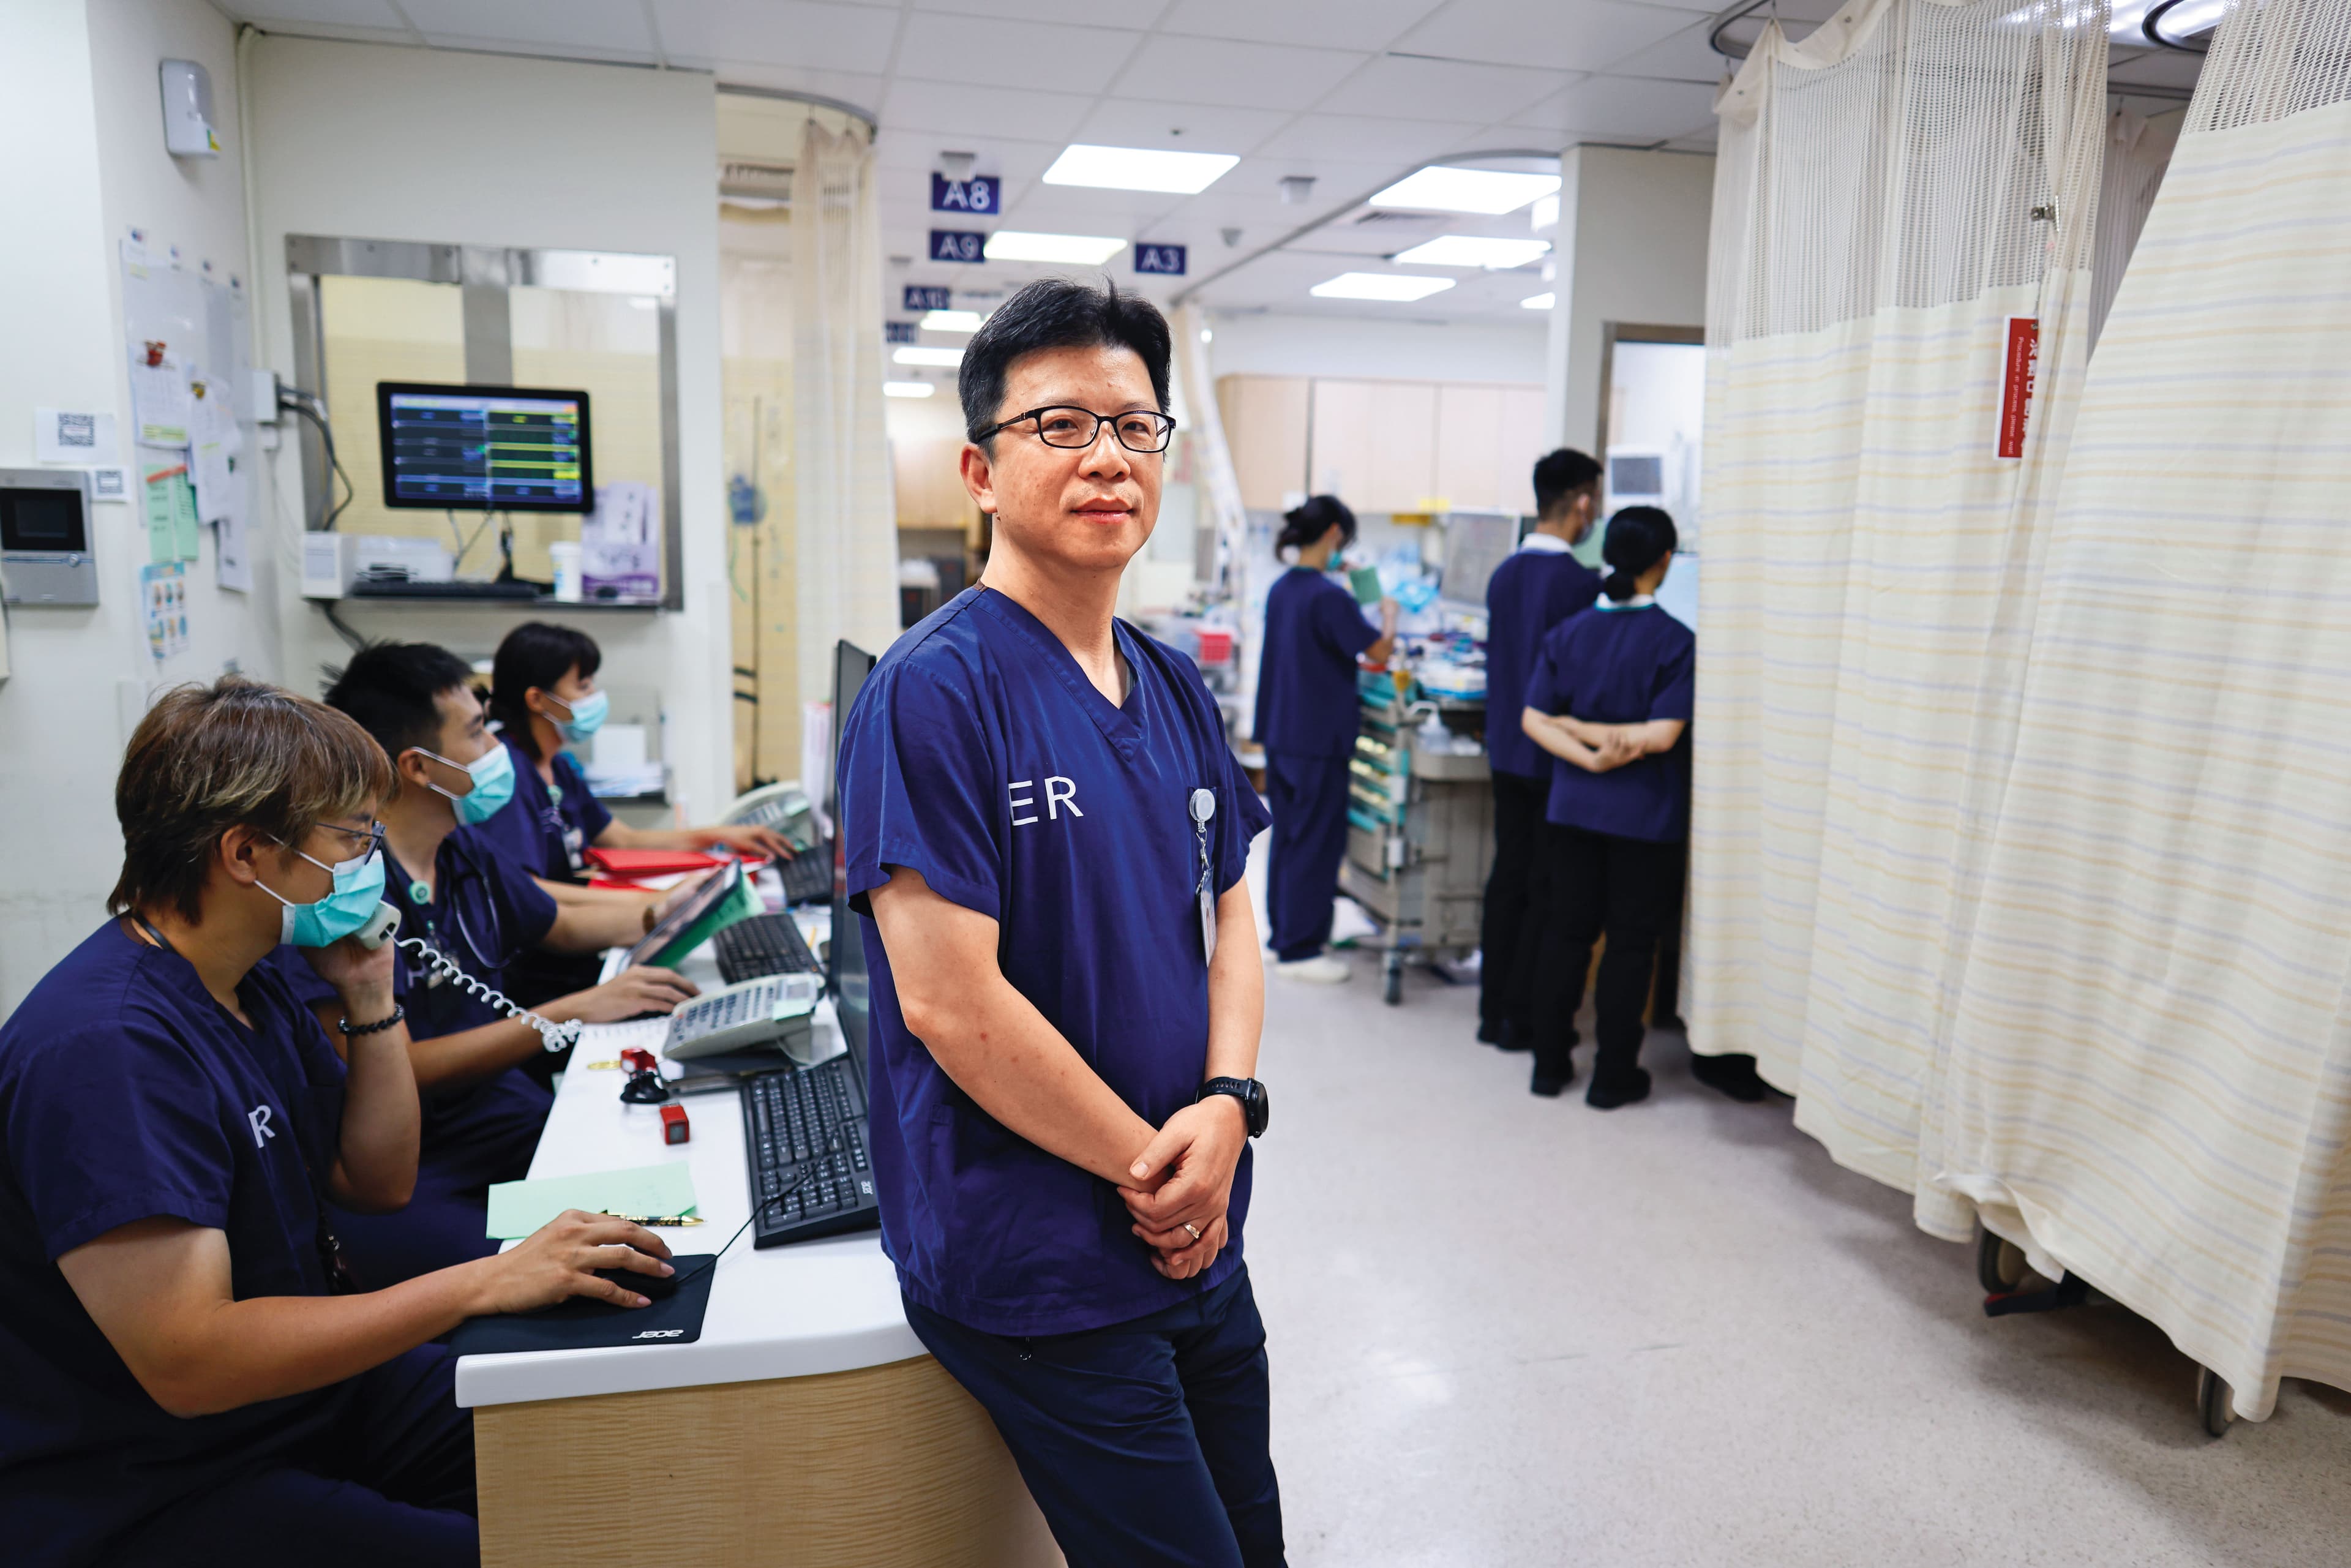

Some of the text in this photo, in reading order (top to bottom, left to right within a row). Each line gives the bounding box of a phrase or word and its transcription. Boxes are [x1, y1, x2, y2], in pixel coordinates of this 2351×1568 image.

[942, 179, 991, 211] A8
[938, 234, 980, 261] A9
[1141, 247, 1180, 271] A3
[1008, 776, 1084, 826] ER
[631, 1329, 684, 1339] acer
